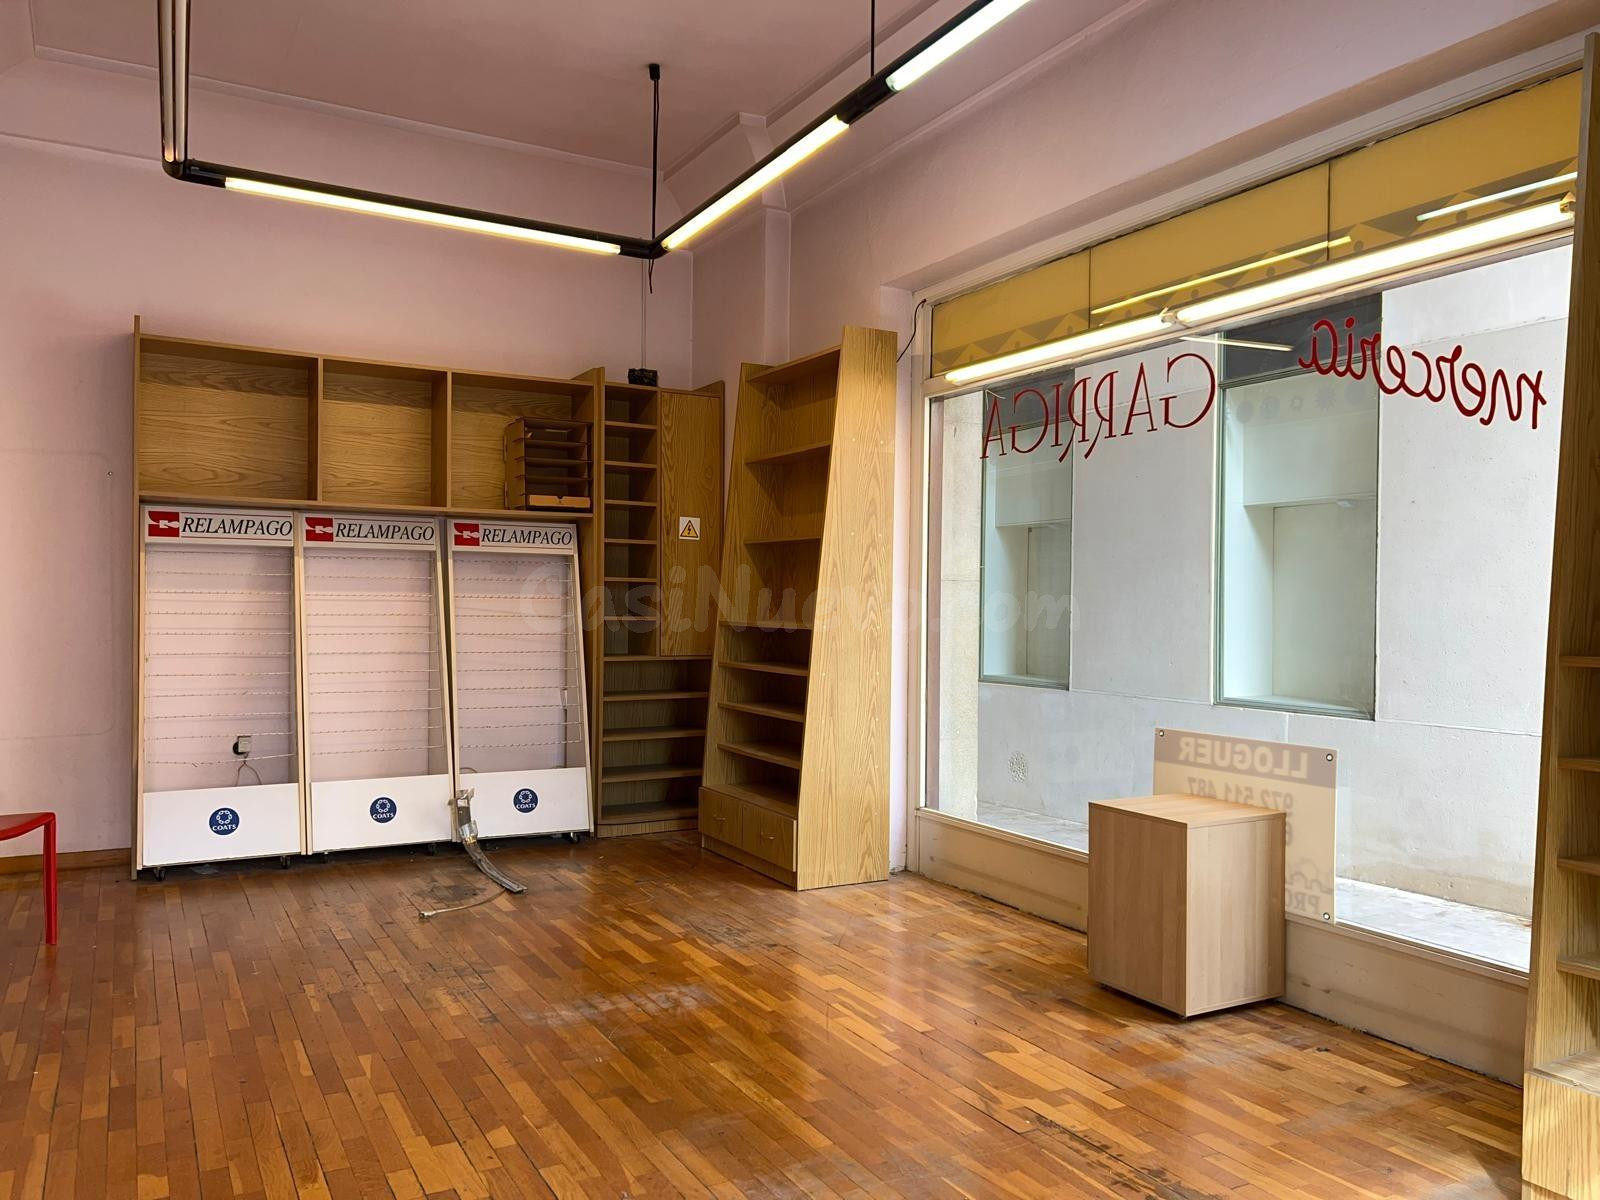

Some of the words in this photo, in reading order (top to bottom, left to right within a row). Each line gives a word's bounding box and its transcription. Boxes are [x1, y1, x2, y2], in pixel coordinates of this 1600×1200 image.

[181, 517, 292, 536] RELAMPAGO
[335, 522, 434, 541] RELAMPAGO
[481, 528, 572, 545] RELAMPAGO
